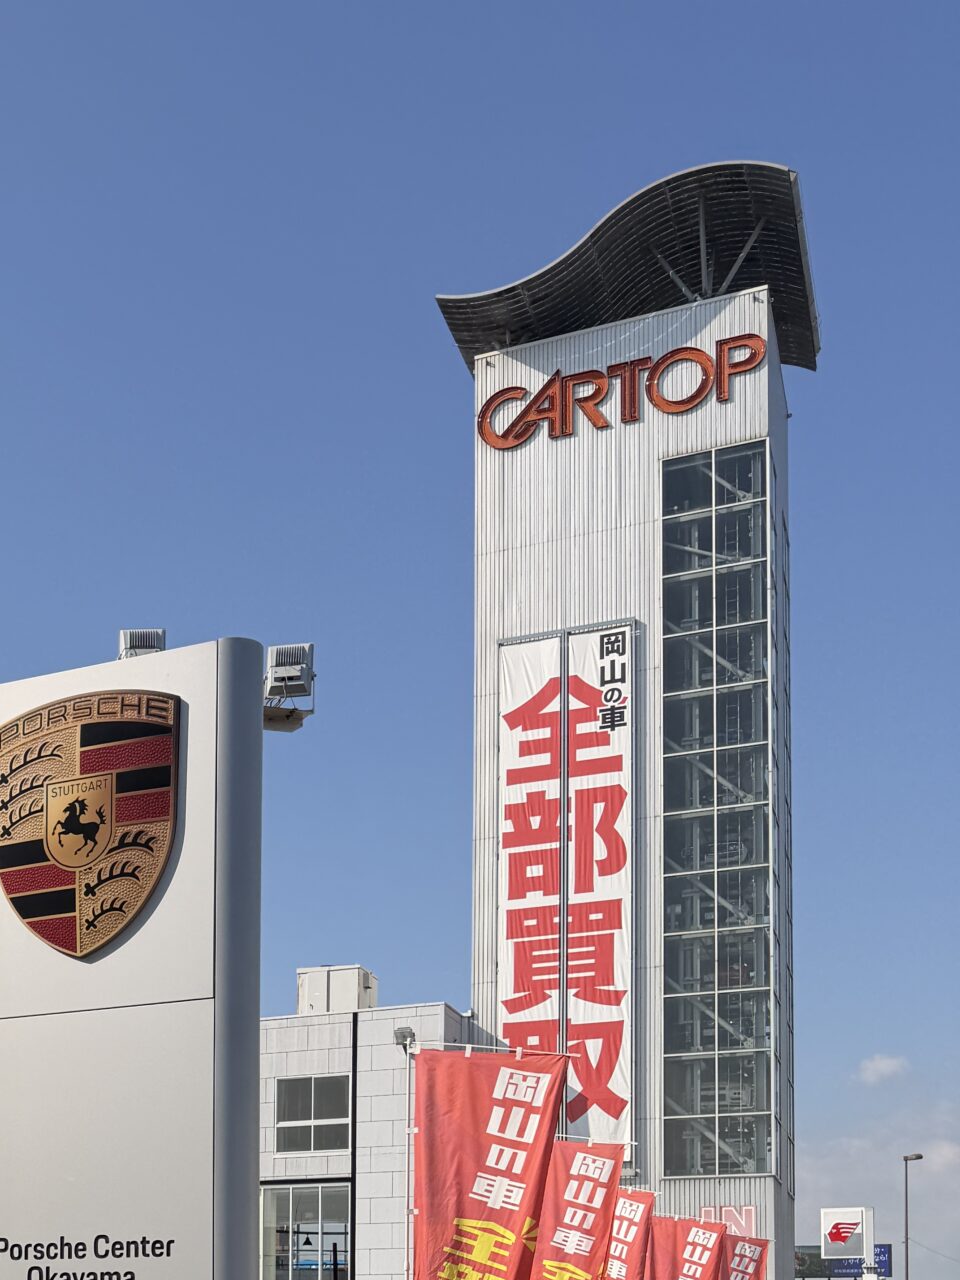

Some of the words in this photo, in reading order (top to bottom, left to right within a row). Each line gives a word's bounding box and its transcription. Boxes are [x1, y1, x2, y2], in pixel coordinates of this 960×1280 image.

[477, 334, 767, 451] CARTOP
[599, 630, 628, 731] 岡山の車
[50, 778, 109, 798] STUTTGART
[468, 1066, 552, 1211] 岡山の車
[93, 1234, 175, 1259] Center
[550, 1151, 615, 1256] 岡山の車
[606, 1197, 646, 1280] 岡山の車
